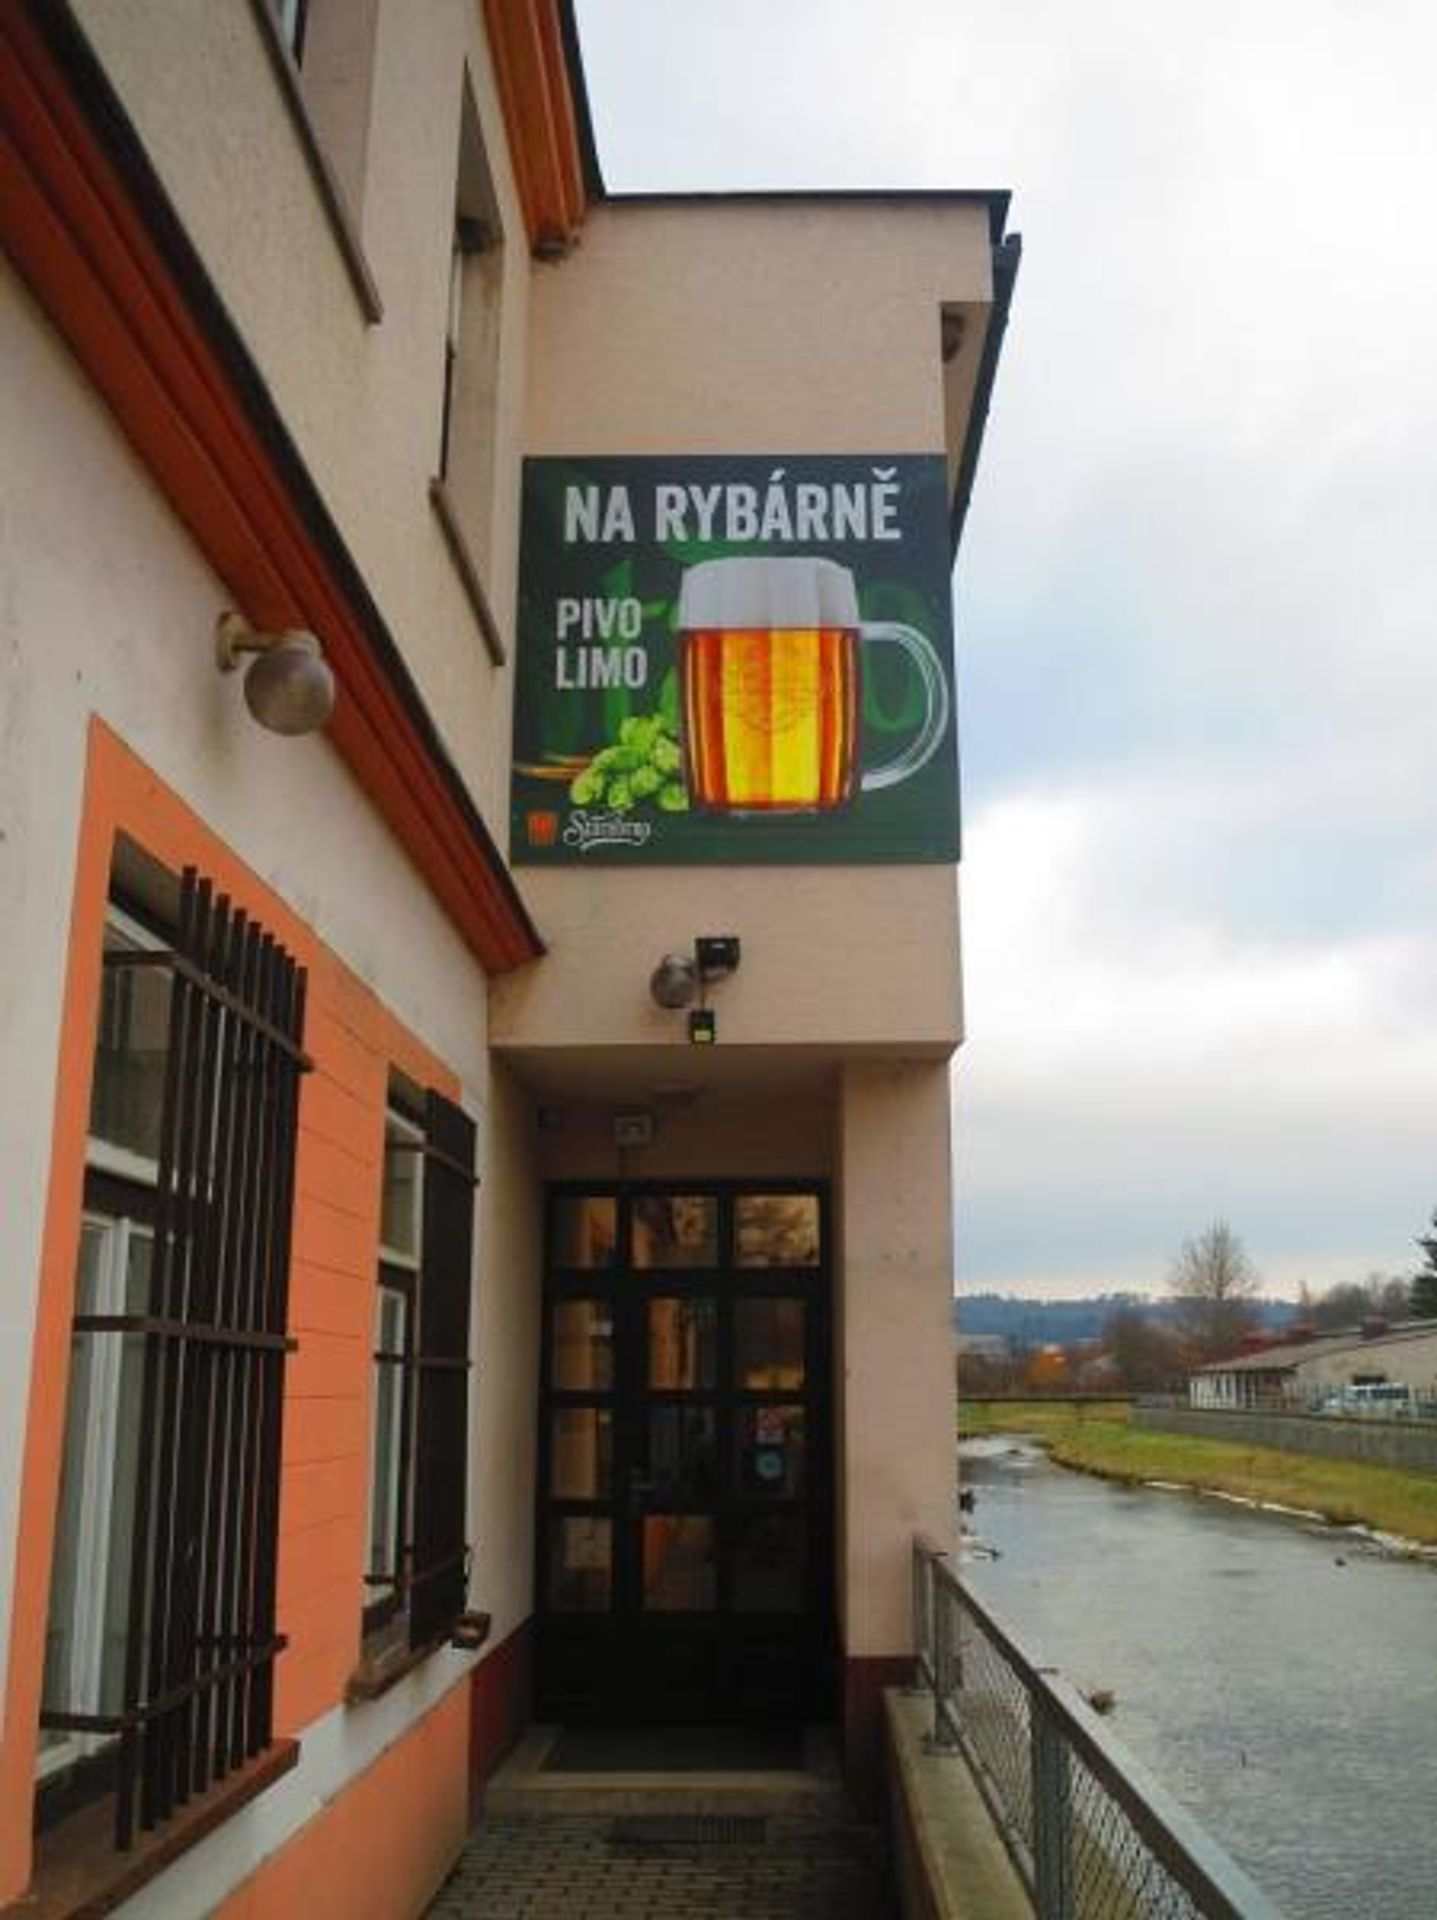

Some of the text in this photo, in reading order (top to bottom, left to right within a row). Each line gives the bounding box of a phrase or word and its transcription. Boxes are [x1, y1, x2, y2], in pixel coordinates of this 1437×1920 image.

[564, 467, 902, 542] NA RYBÁRNĚ
[555, 597, 643, 640] PIVO
[555, 646, 648, 690] LIMO
